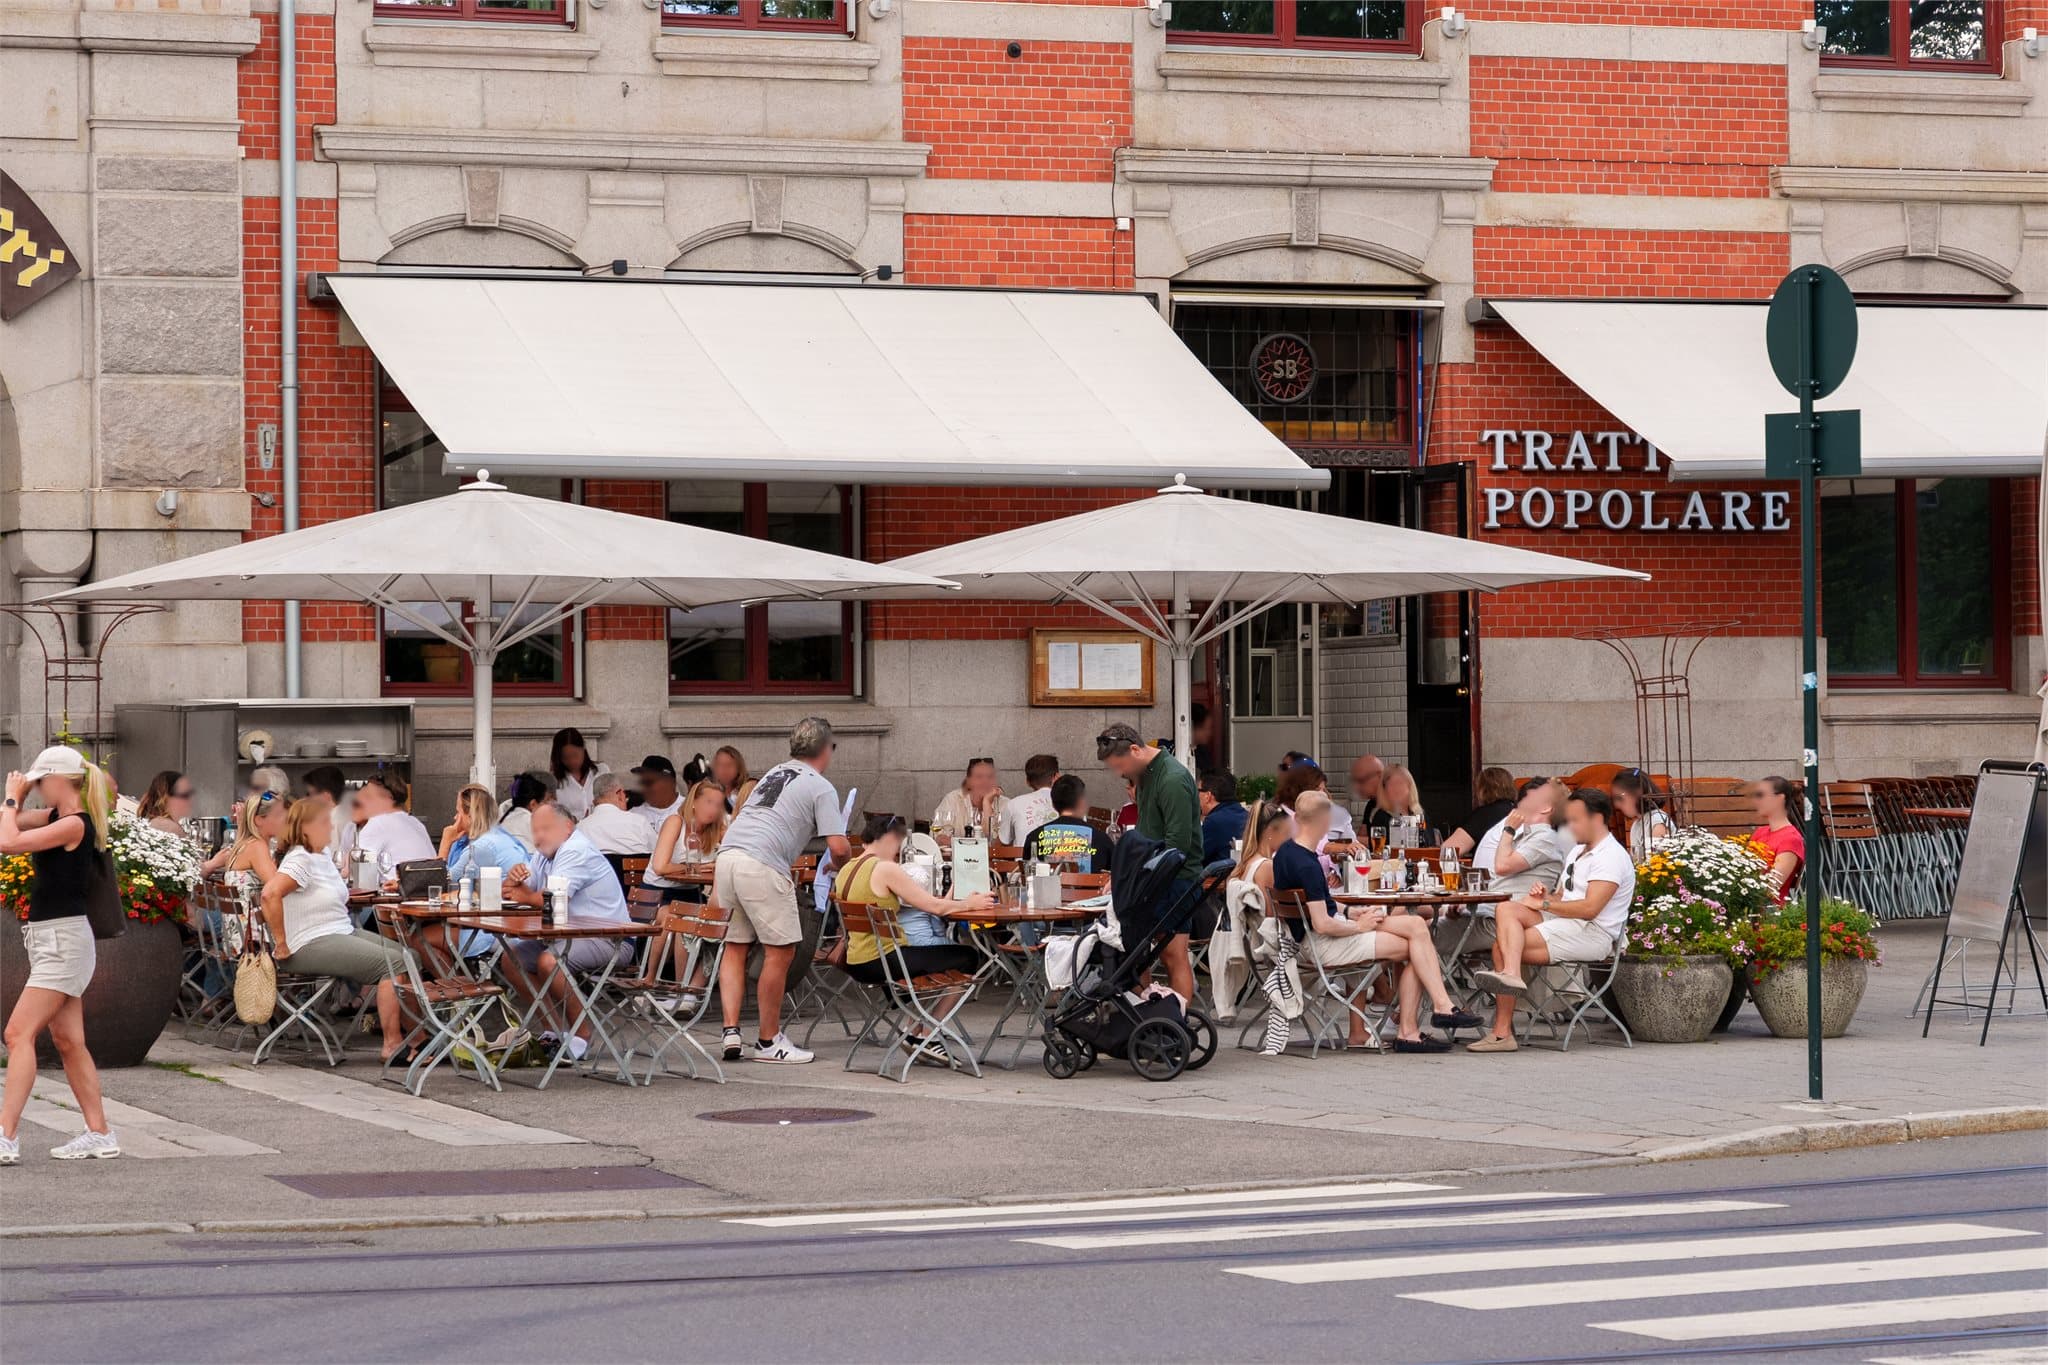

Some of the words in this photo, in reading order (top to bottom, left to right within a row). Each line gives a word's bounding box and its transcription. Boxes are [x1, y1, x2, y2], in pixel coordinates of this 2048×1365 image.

[1273, 359, 1297, 379] SB
[1483, 487, 1791, 531] POPOLARE
[1038, 838, 1061, 847] VENICE
[1038, 847, 1053, 855] LOS
[1053, 845, 1086, 853] ANGELES
[774, 1049, 789, 1060] N
